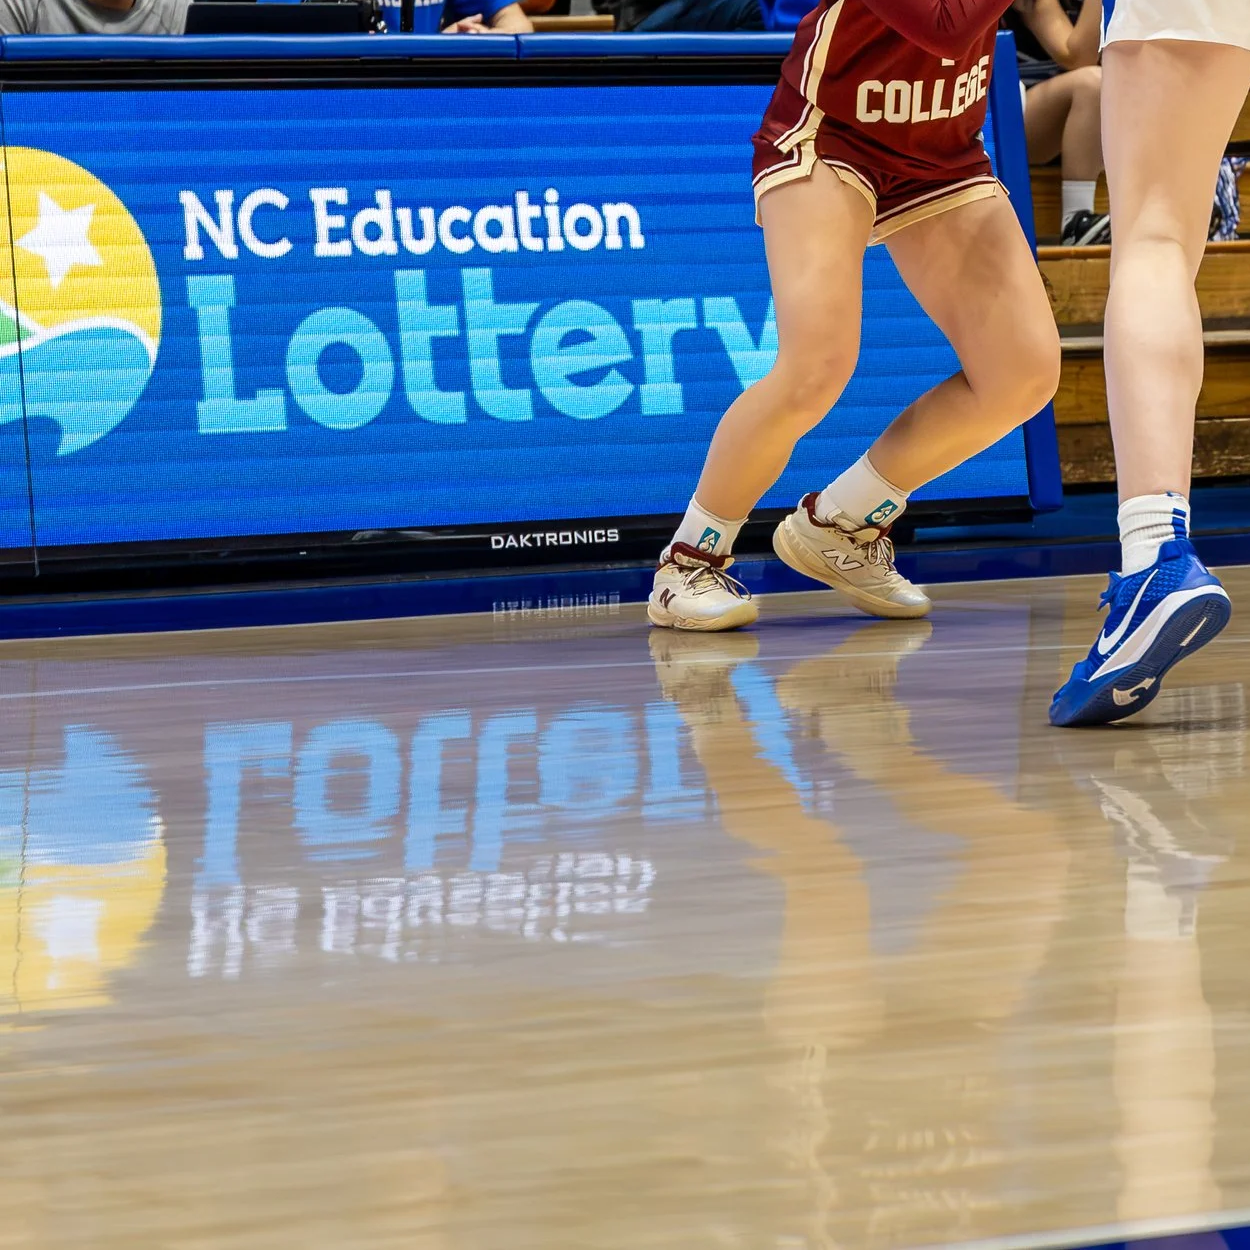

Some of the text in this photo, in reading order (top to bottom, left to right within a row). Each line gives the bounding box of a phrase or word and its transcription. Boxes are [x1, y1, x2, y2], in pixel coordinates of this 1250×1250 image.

[856, 55, 990, 124] COLLEGE
[179, 187, 645, 261] NC Education
[491, 529, 620, 549] DAKTRONICS
